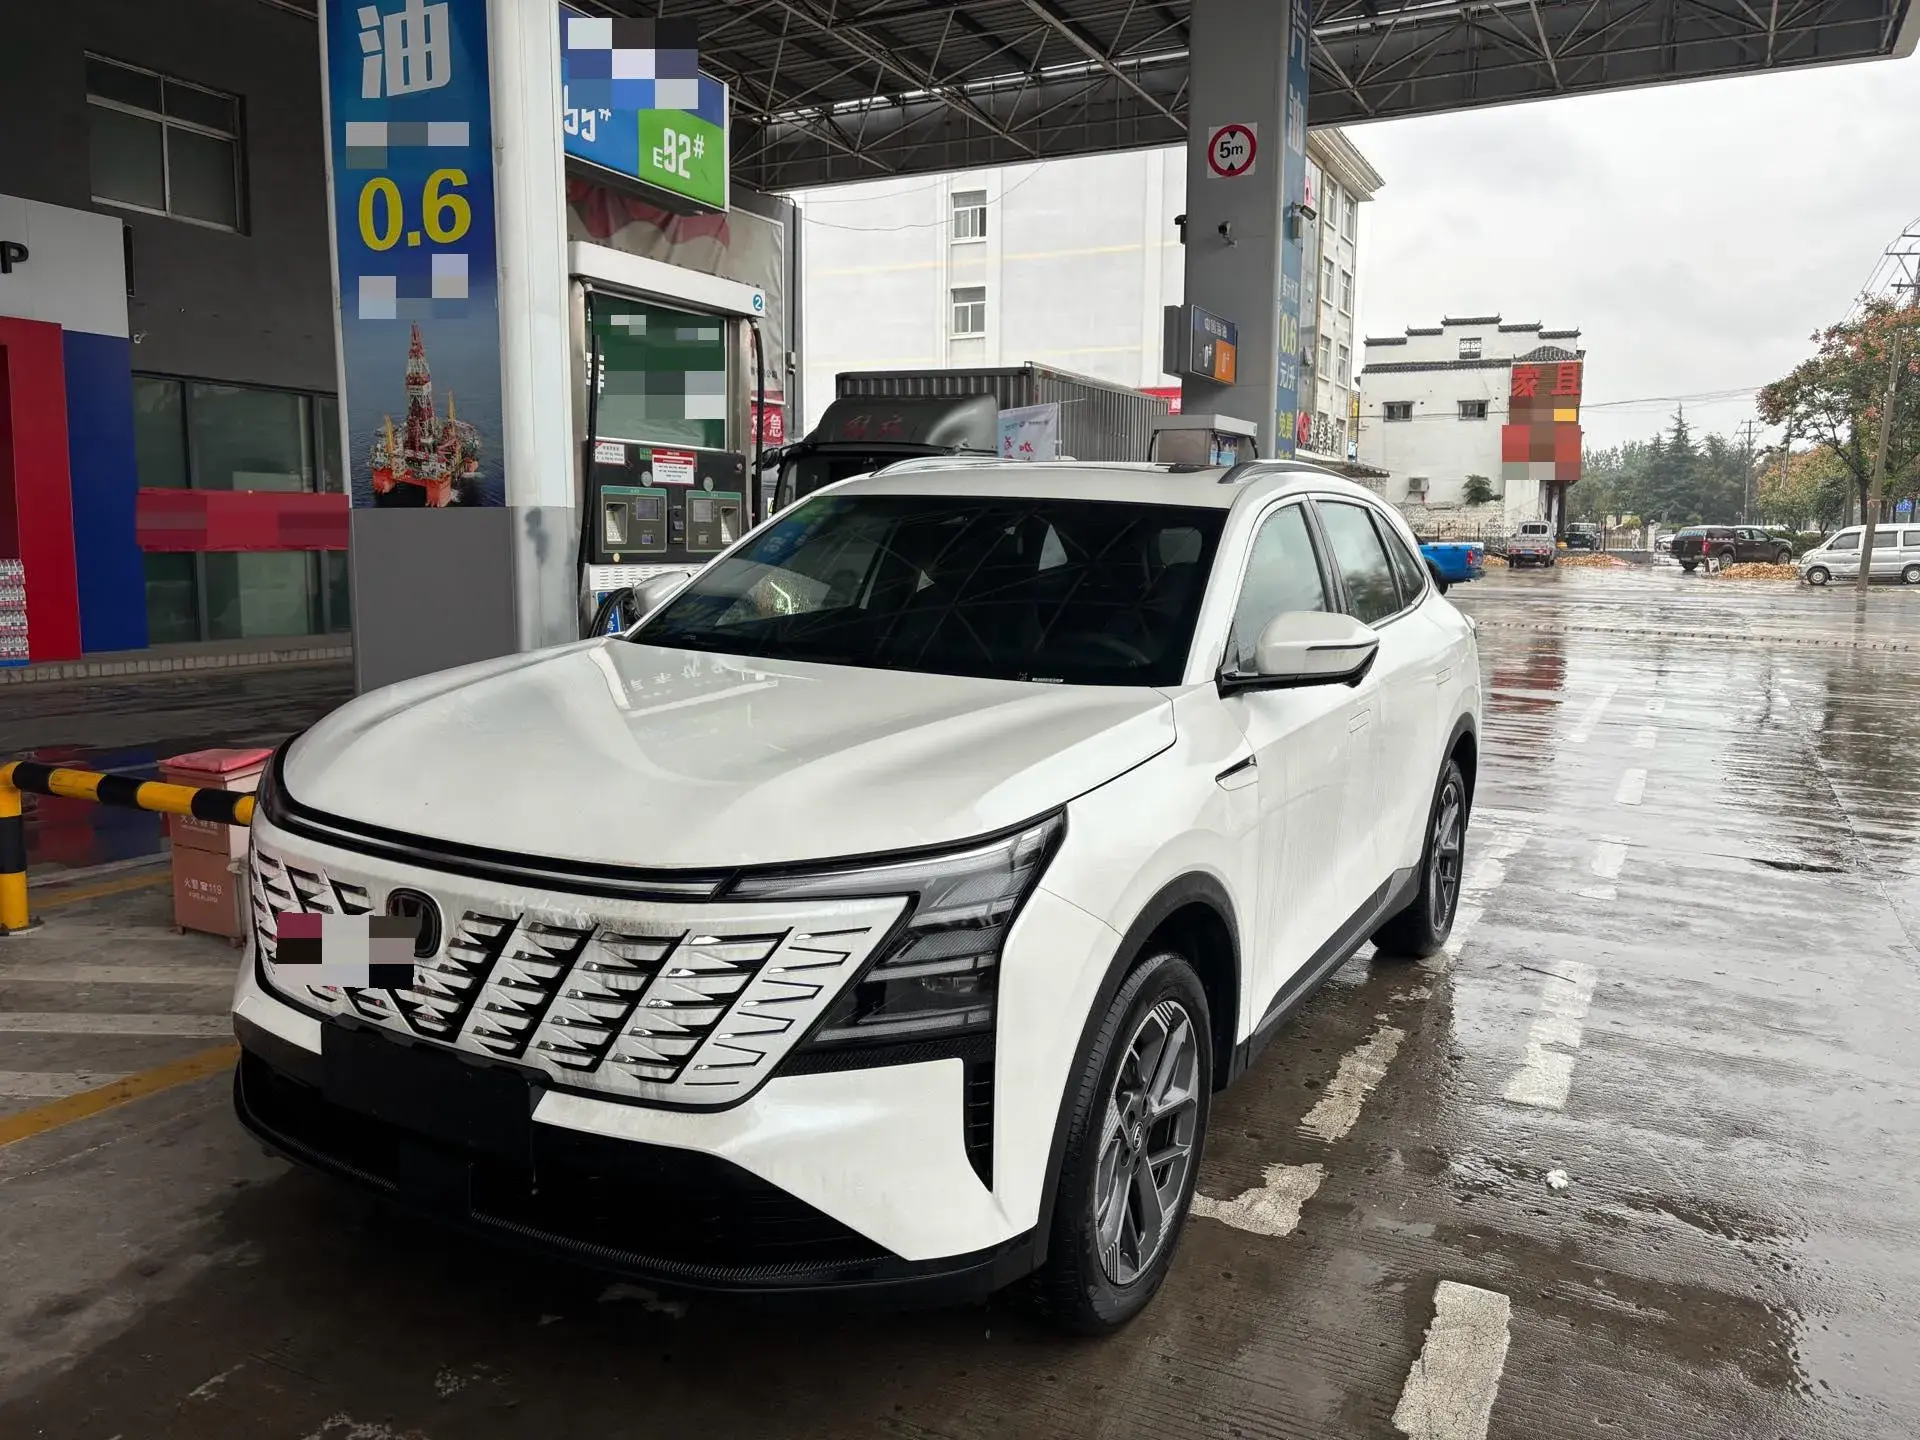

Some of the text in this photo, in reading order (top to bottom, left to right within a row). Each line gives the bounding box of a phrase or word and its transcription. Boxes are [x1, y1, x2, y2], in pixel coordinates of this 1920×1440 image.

[357, 0, 451, 98] 油
[652, 127, 705, 180] E92#
[1219, 140, 1243, 159] 5m
[358, 168, 472, 252] 0.6
[1280, 313, 1298, 356] 0.6
